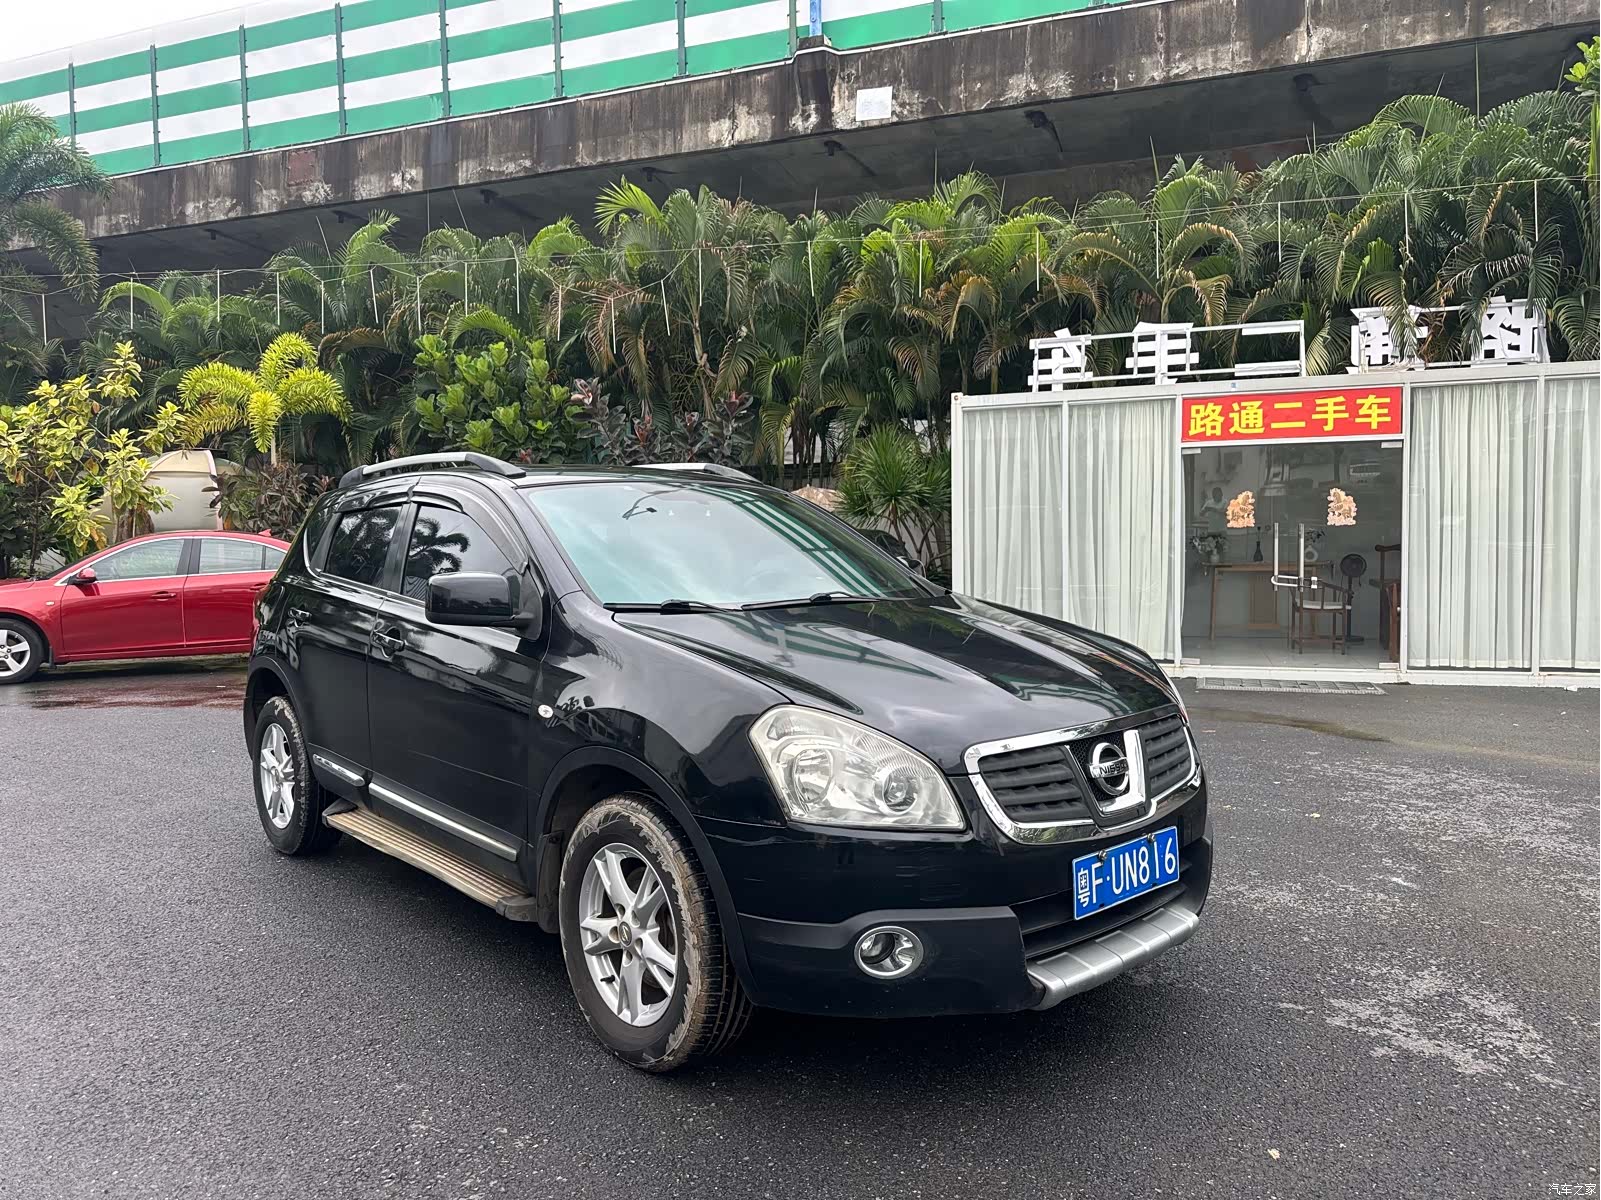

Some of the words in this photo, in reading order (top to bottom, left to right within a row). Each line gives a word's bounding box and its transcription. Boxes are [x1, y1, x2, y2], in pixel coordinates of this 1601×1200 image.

[1188, 394, 1392, 437] 路通二手车
